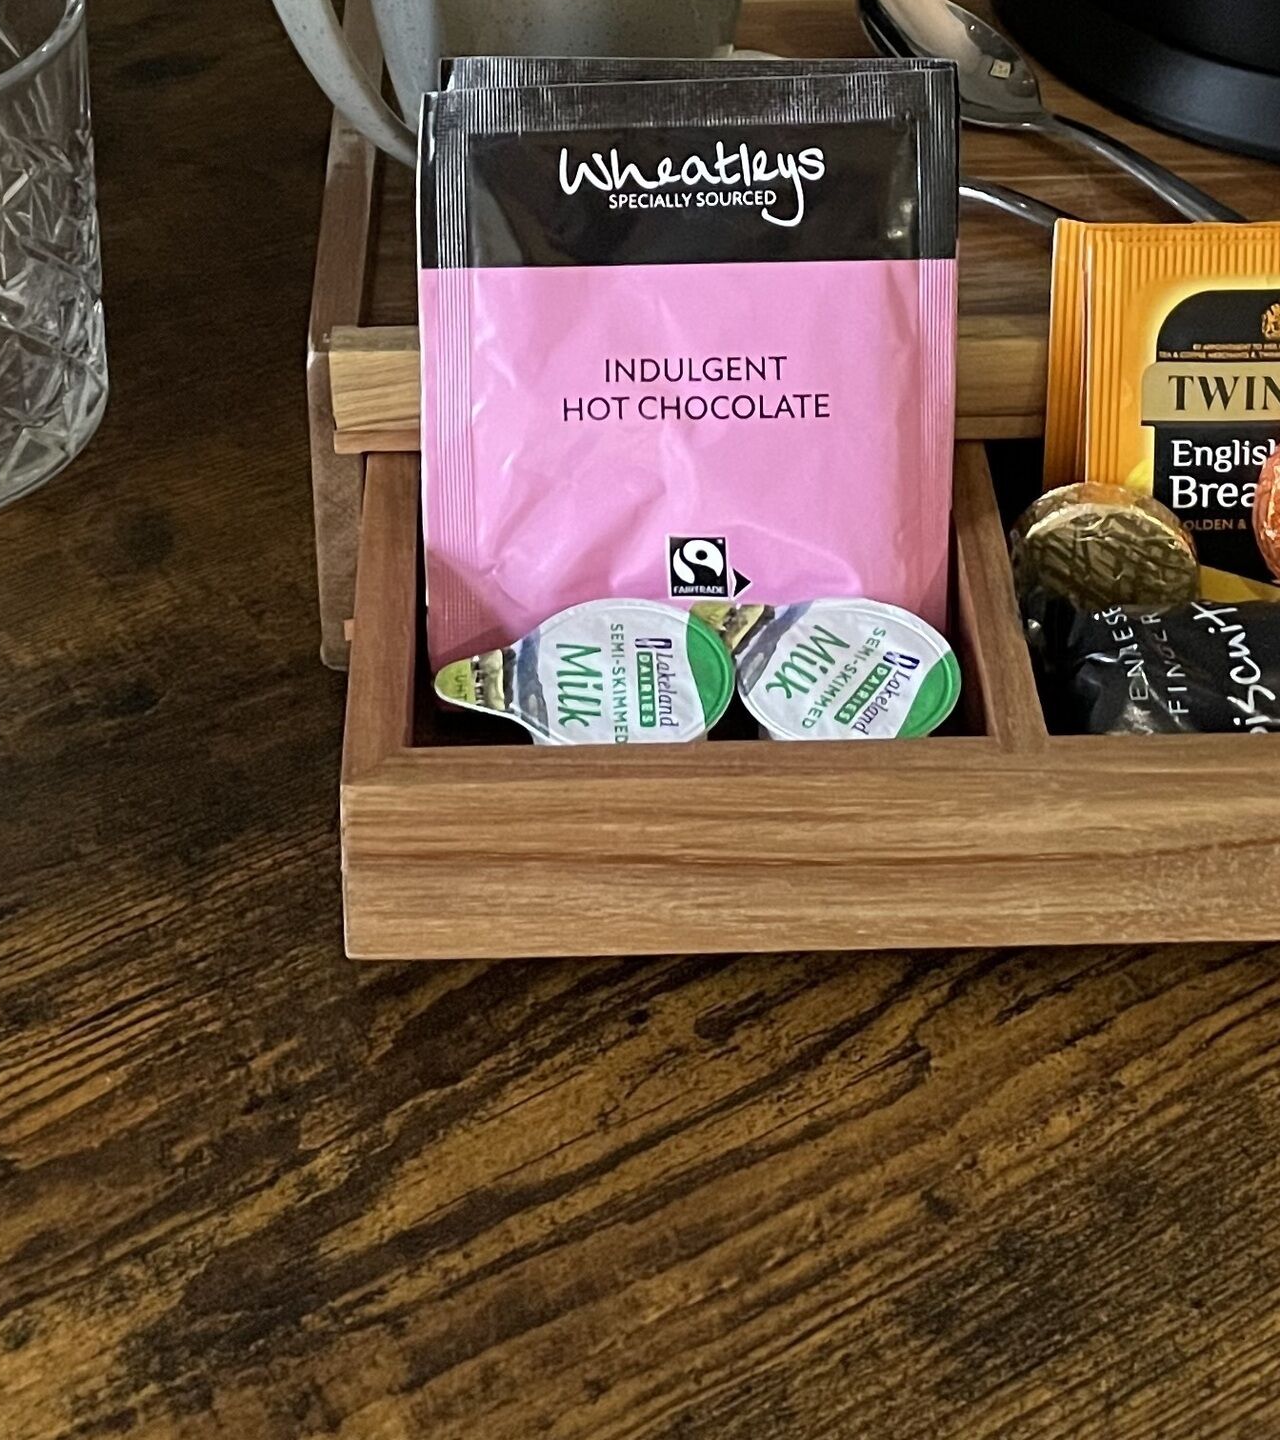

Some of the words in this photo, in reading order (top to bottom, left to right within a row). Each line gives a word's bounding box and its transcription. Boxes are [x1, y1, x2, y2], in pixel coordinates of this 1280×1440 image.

[559, 141, 826, 227] Wheatleys
[608, 191, 693, 210] SPECIALLY
[695, 189, 778, 207] SOURCED
[604, 356, 788, 383] INDULGENT
[563, 396, 630, 422] HOT
[637, 393, 831, 421] CHOCOLATE
[556, 643, 604, 729] Milk
[610, 623, 629, 744] SEMI-SKIMMED
[637, 652, 656, 727] DAIRIES
[656, 652, 680, 729] Lakeland
[765, 624, 851, 700] Milk
[802, 626, 887, 729] SEMI-SKIMMED
[836, 664, 891, 723] DAIRIES
[851, 667, 912, 736] Lakeland
